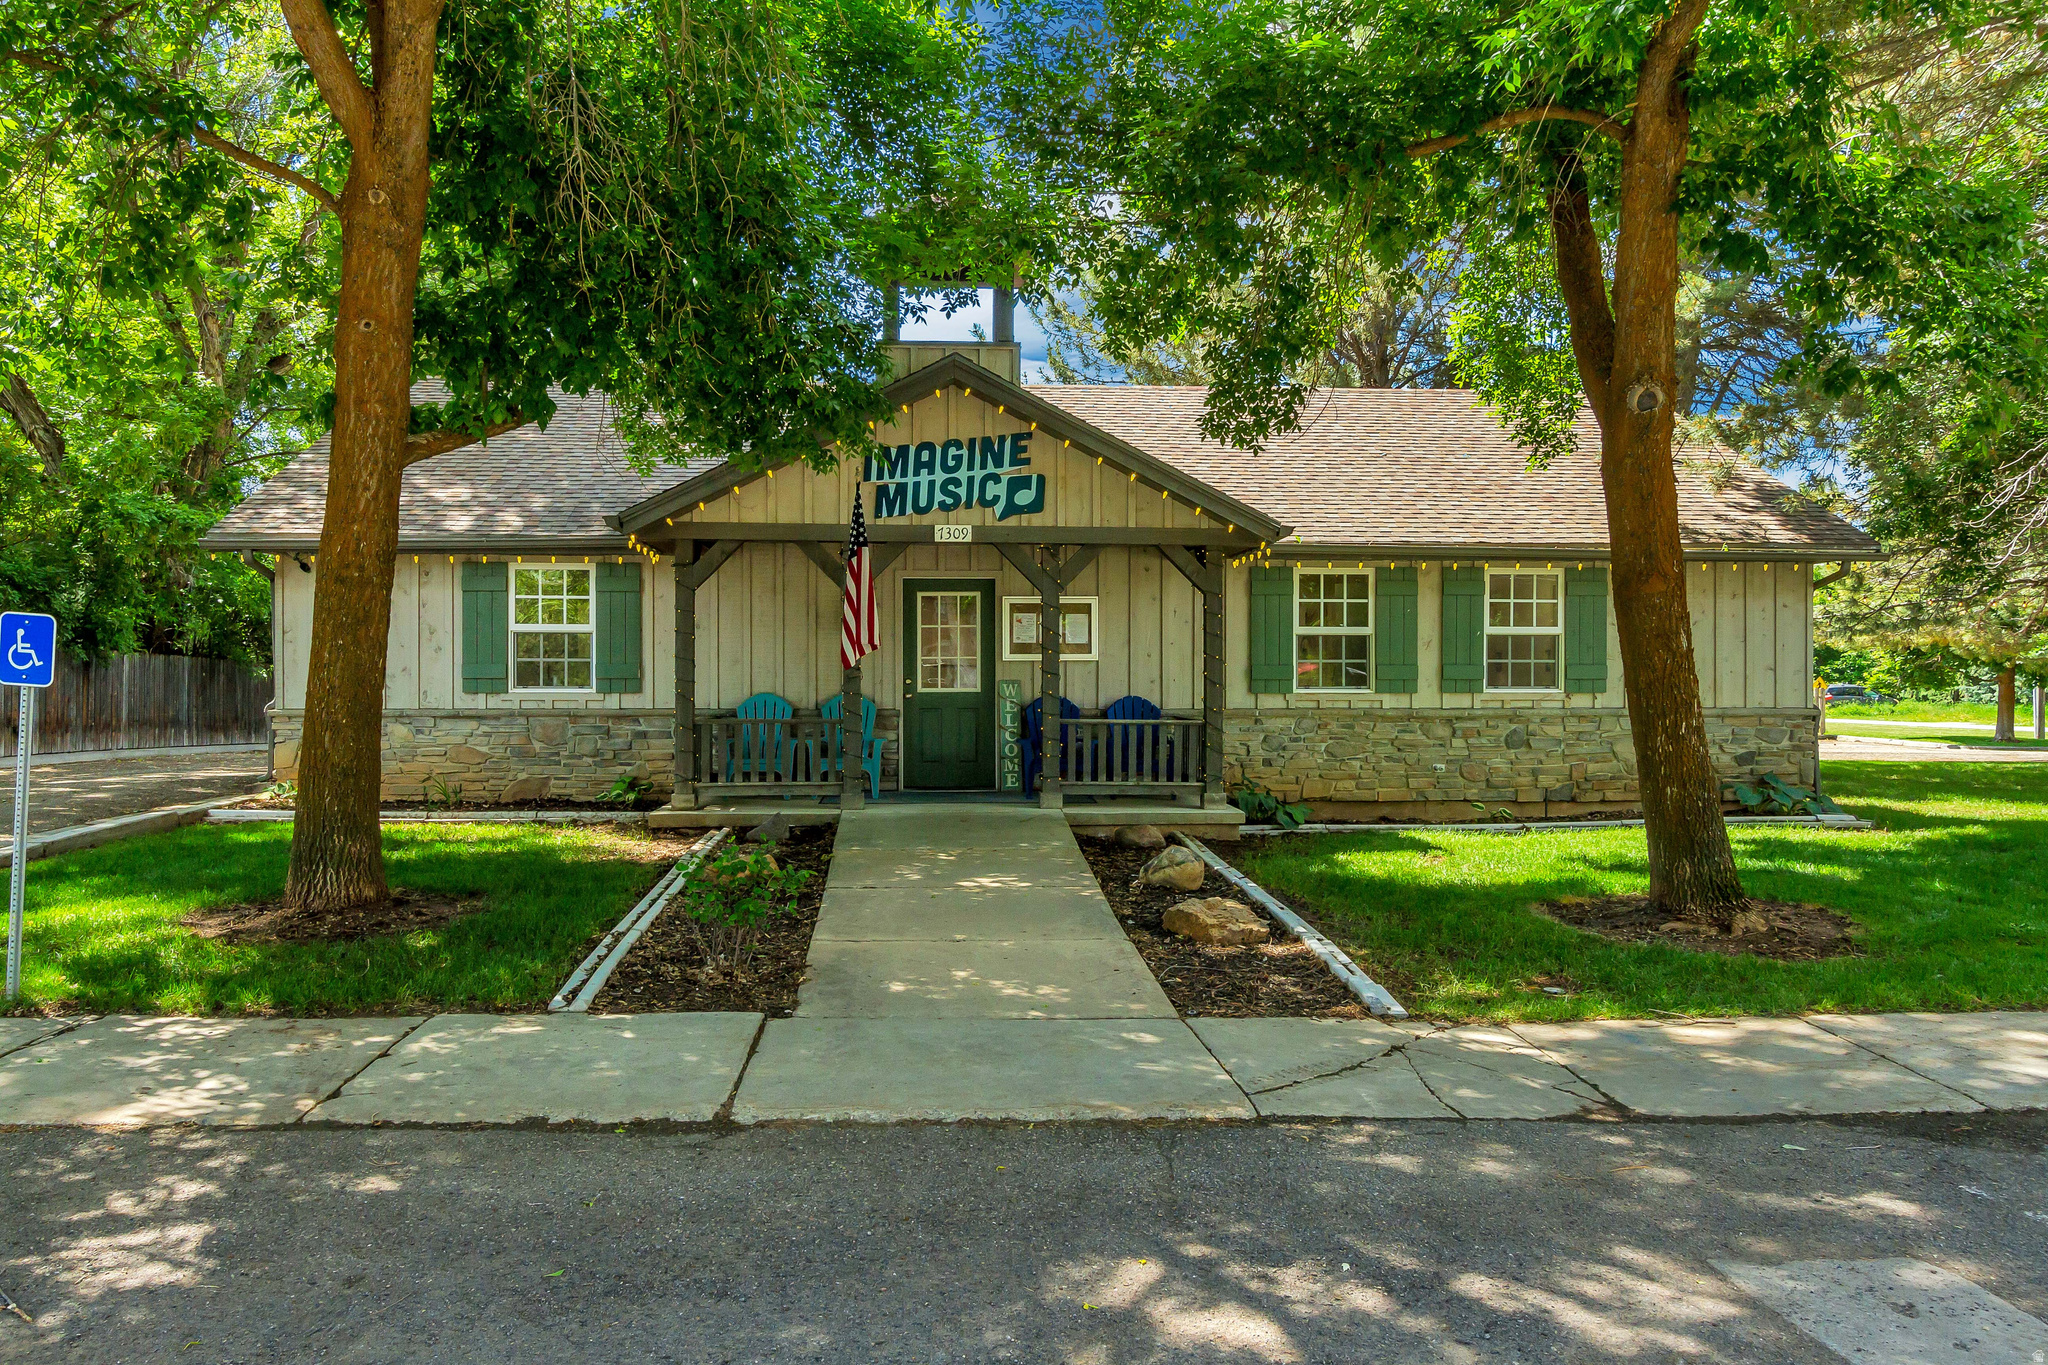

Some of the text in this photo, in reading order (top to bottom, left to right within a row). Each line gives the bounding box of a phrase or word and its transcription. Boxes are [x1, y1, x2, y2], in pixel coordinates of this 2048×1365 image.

[863, 431, 1033, 482] IMAGINE
[874, 472, 1002, 519] MUSIC
[937, 526, 969, 541] 1309
[1002, 683, 1019, 788] WELCOME
